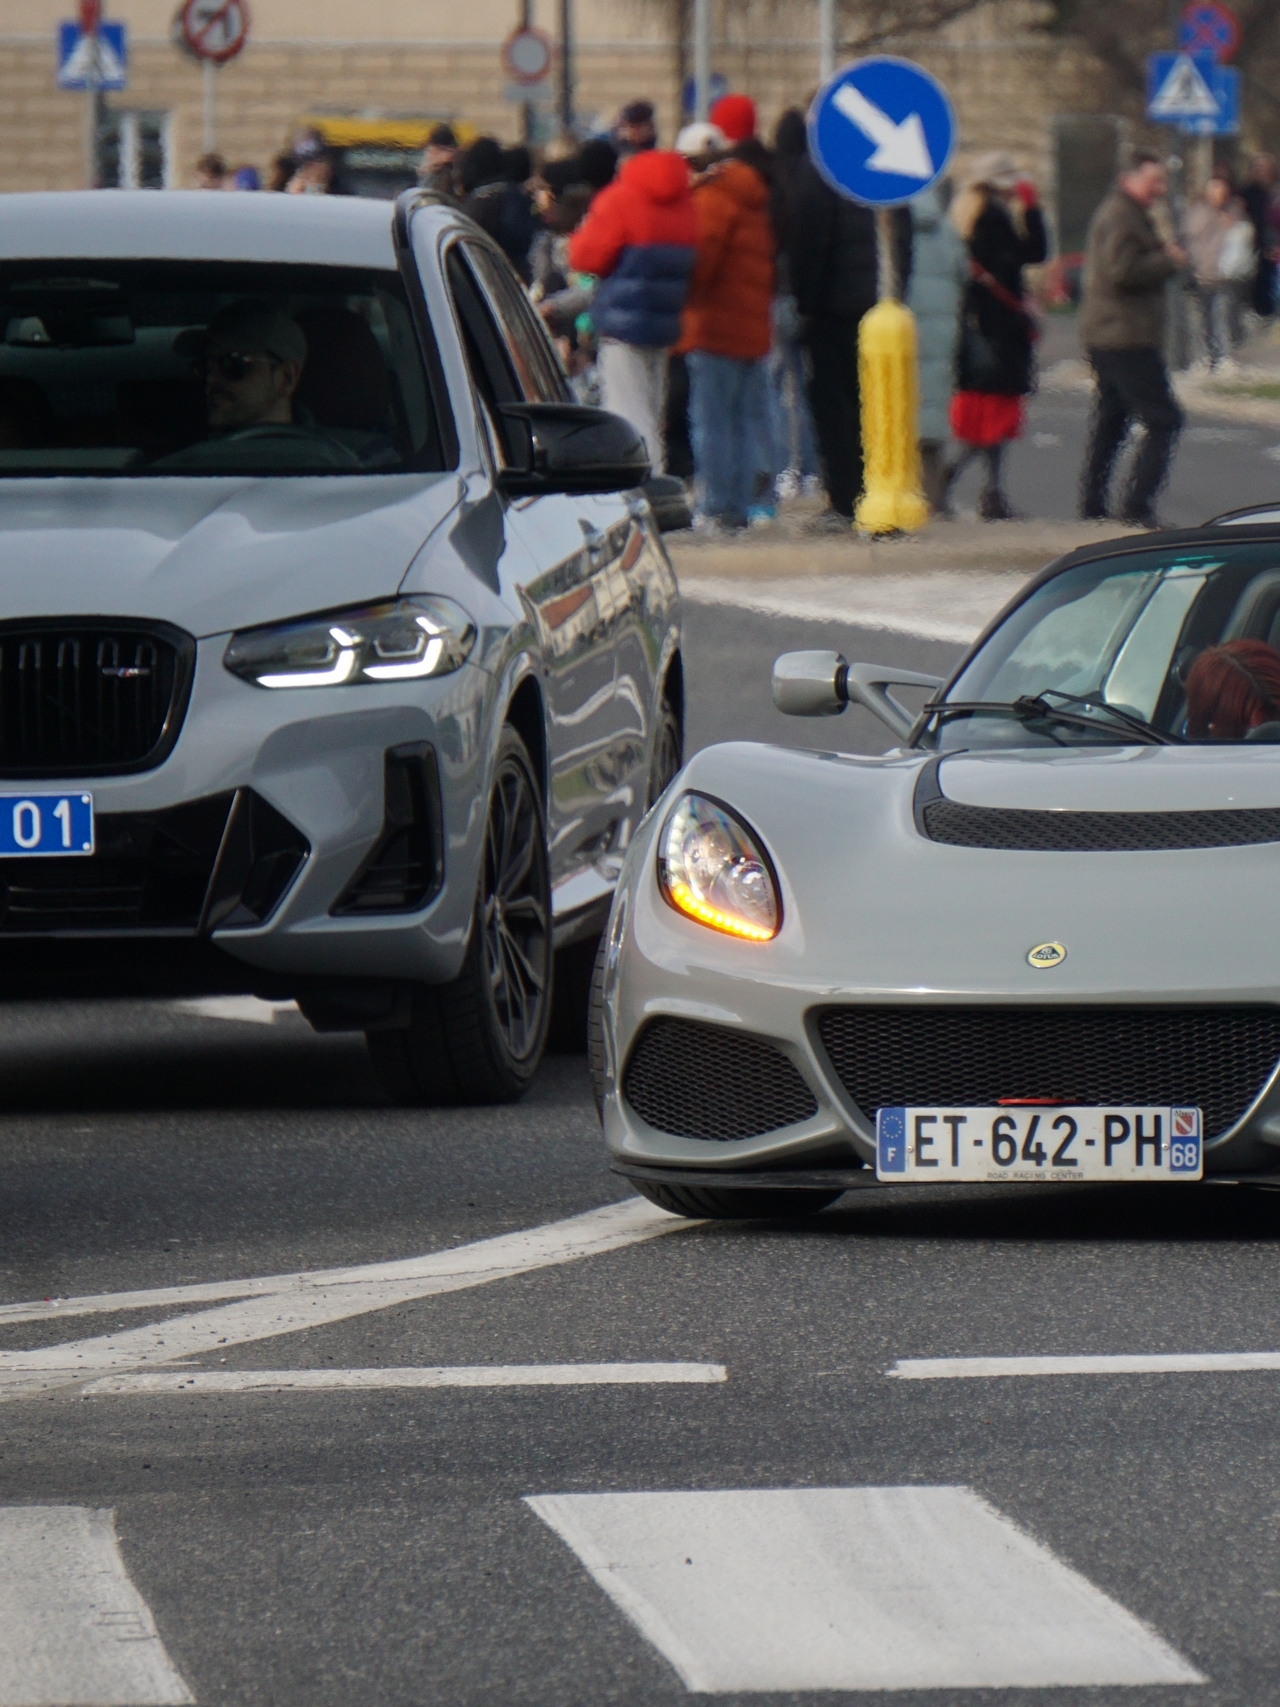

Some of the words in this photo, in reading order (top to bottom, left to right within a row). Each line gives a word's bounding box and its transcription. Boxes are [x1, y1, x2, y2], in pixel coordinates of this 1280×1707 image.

[13, 799, 71, 849] 01
[1174, 1109, 1195, 1117] Alsace
[915, 1114, 1162, 1168] ET-642-PH
[887, 1147, 897, 1162] F
[1171, 1143, 1197, 1168] 68
[987, 1172, 1009, 1180] ROAD
[1013, 1172, 1046, 1180] RACING
[1050, 1172, 1084, 1180] CENTER
